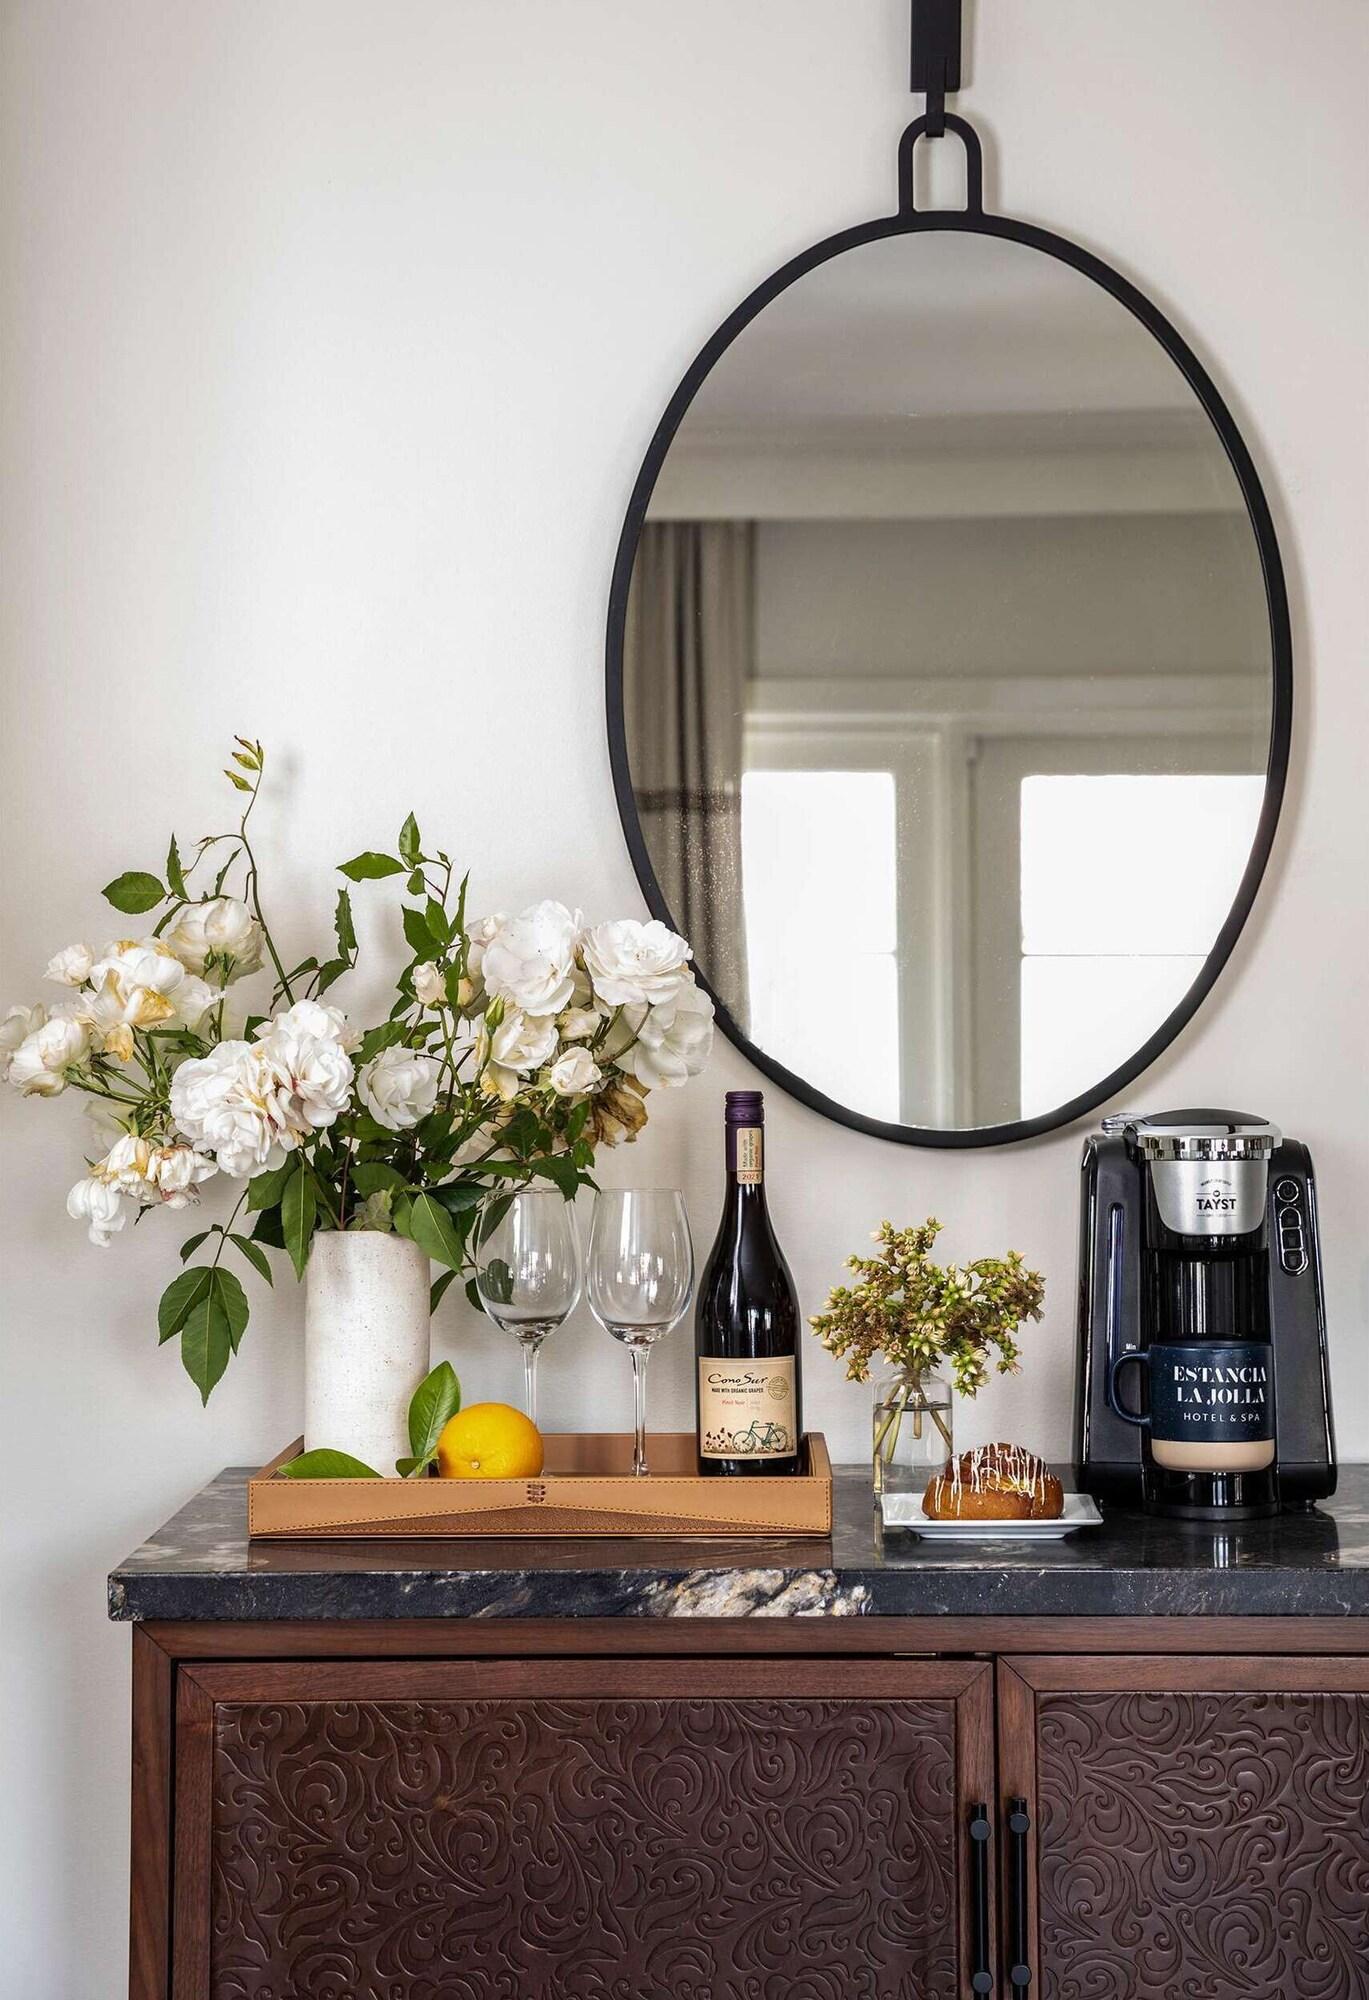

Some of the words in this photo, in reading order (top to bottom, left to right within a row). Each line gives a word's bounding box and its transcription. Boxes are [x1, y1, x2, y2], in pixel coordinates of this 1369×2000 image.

[1196, 1199, 1237, 1210] TAYST
[707, 1373, 741, 1385] Cono
[737, 1372, 768, 1387] Sur
[1173, 1365, 1267, 1383] ESTANCIA
[1176, 1387, 1202, 1403] LA
[1206, 1387, 1265, 1406] JOLLA
[1183, 1413, 1225, 1422] HOTEL
[1229, 1413, 1237, 1423] &
[1241, 1413, 1260, 1422] SPA
